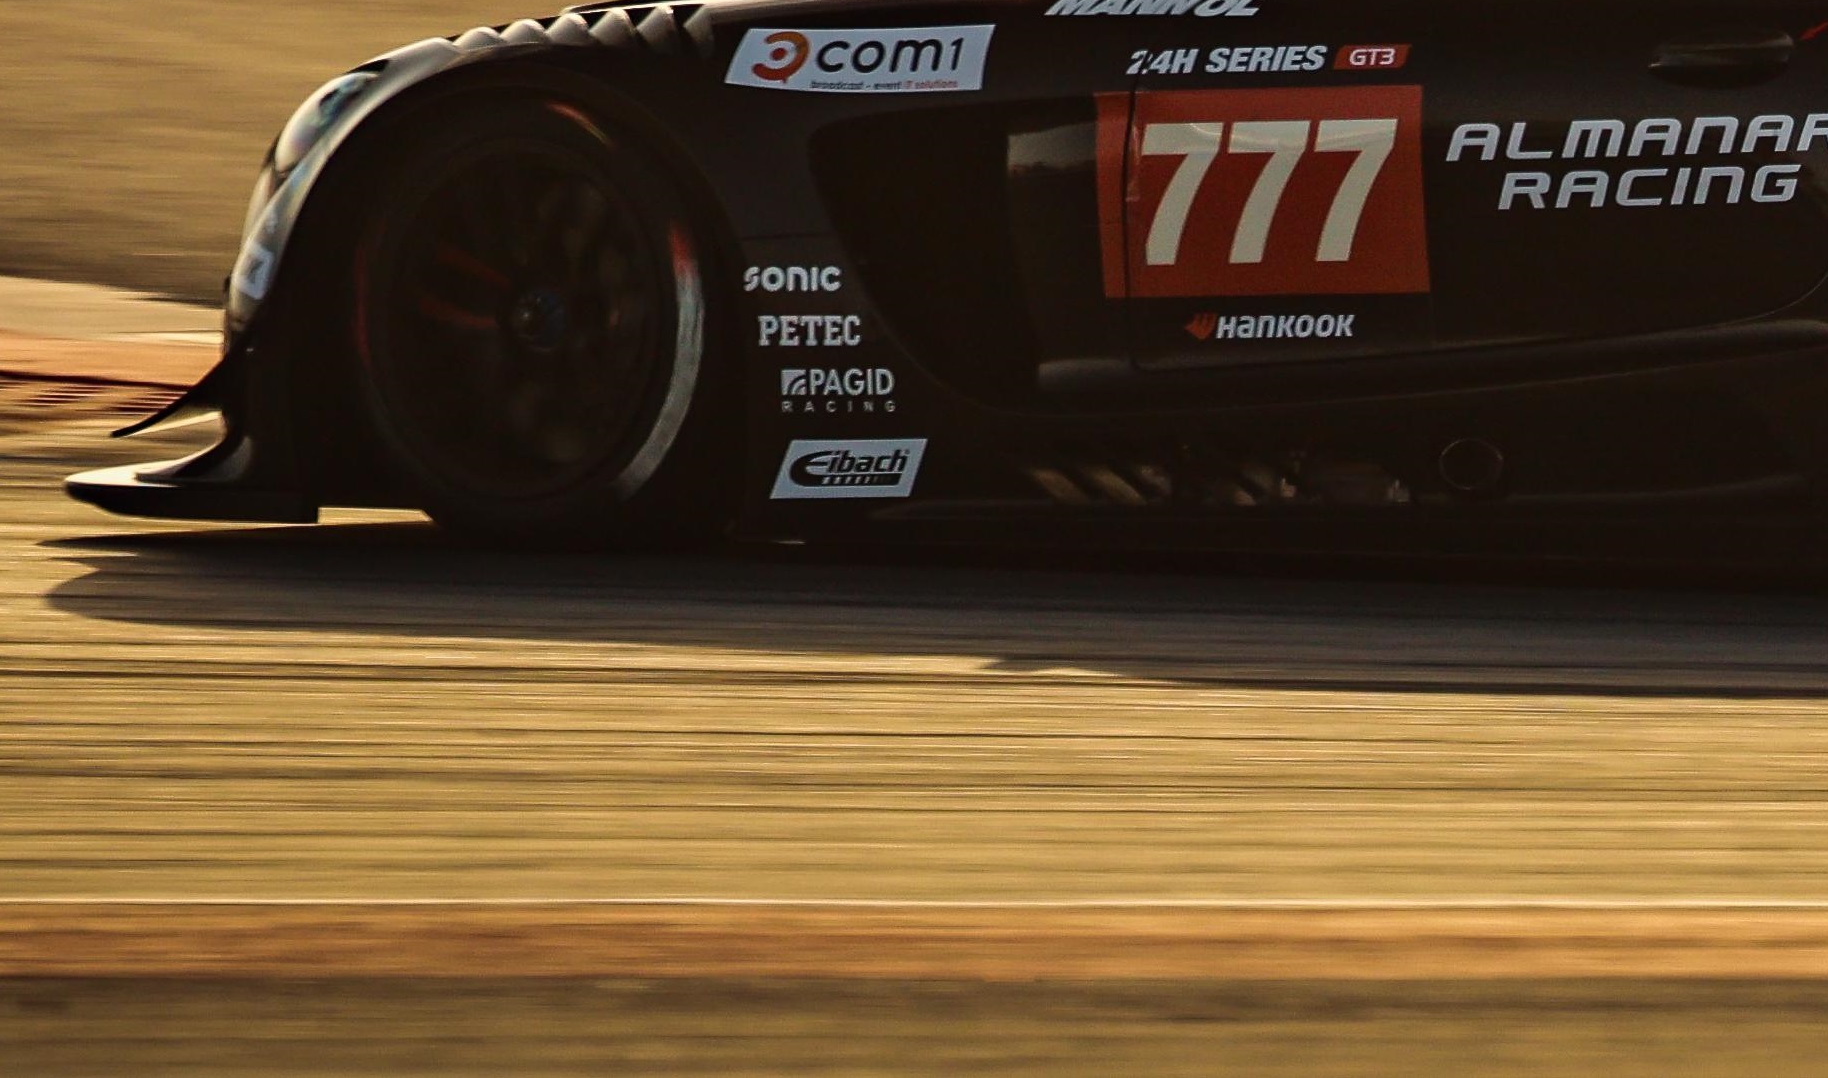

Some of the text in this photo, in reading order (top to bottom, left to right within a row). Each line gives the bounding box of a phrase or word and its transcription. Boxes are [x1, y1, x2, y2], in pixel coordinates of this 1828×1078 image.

[815, 36, 965, 74] com1
[1126, 45, 1328, 75] 24H SERIES
[1349, 47, 1396, 67] GT3
[1141, 118, 1398, 266] 777
[1498, 163, 1802, 210] RACING
[757, 315, 861, 347] PETEC
[809, 367, 896, 396] PAGID
[781, 400, 897, 413] RACING
[788, 448, 910, 488] Eibach
